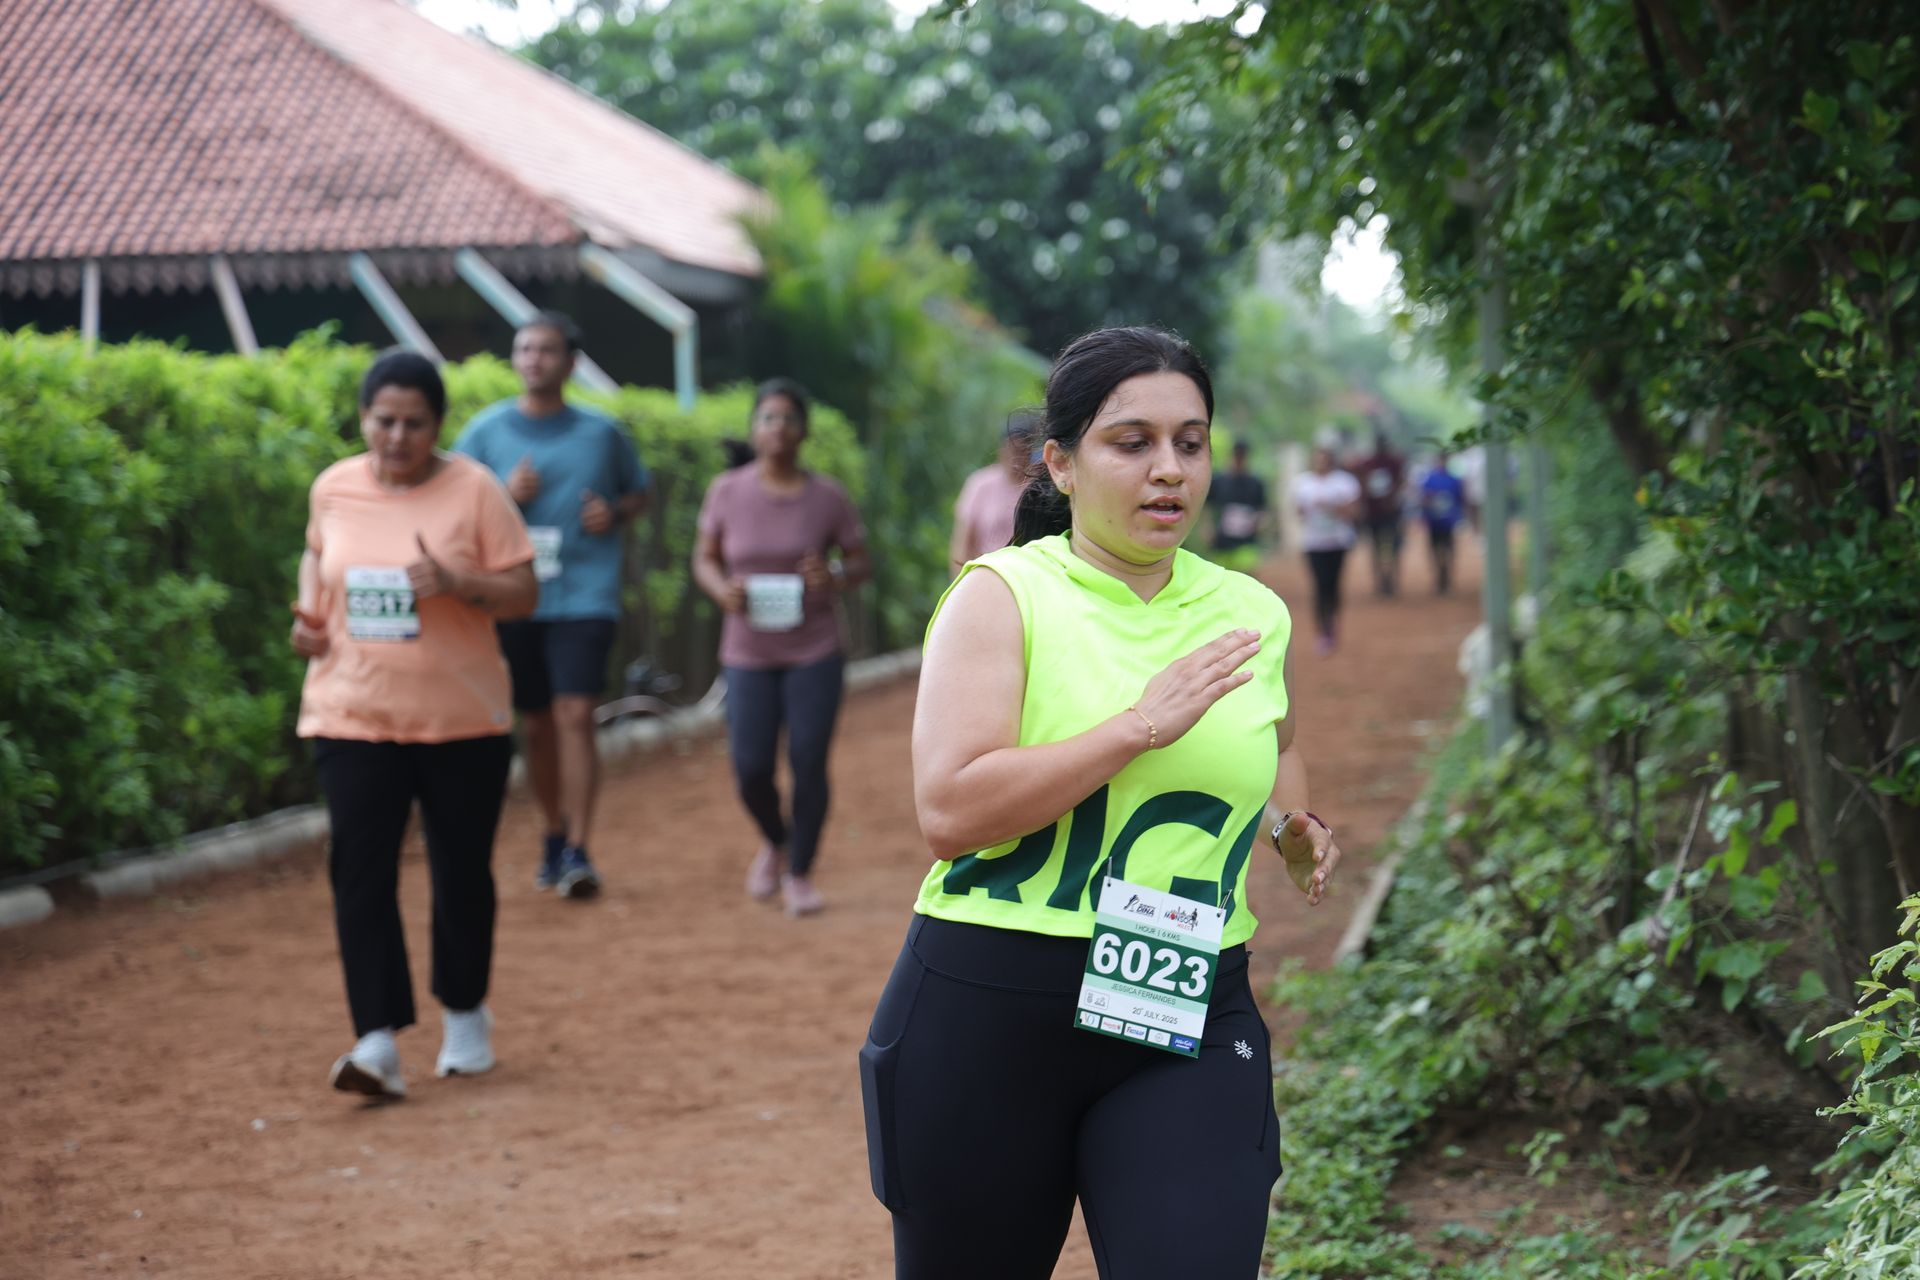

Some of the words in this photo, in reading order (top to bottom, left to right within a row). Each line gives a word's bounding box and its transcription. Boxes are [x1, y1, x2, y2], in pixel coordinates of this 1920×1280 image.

[1138, 925, 1155, 935] HOUR
[1167, 932, 1181, 941] KMS
[1092, 932, 1210, 998] 6023
[1111, 983, 1137, 996] JESSICA
[1137, 989, 1177, 1006] FERNANDES
[1161, 1014, 1179, 1025] 2025
